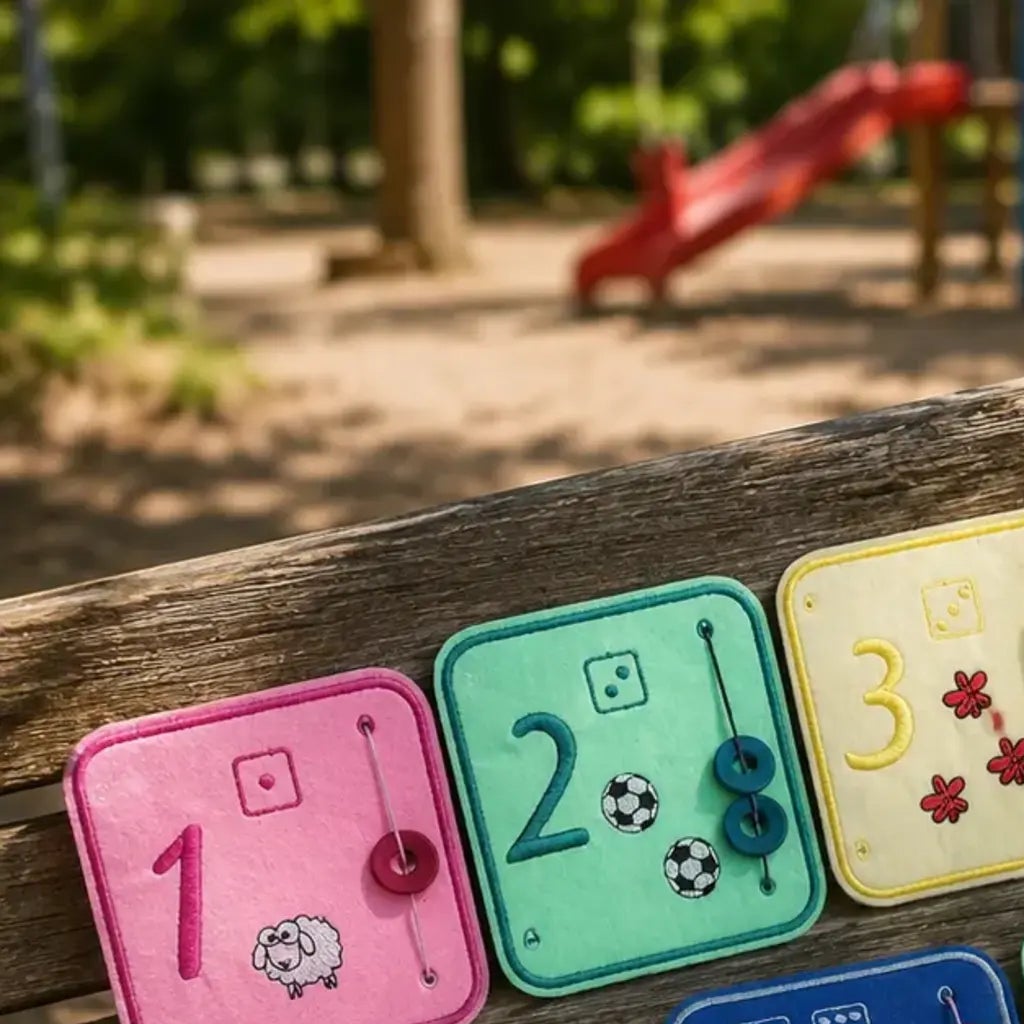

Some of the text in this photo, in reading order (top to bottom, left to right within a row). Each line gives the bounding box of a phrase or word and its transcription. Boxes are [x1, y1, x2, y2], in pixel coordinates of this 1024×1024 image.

[844, 637, 917, 770] 3
[506, 711, 590, 864] 2
[151, 823, 204, 980] 1
